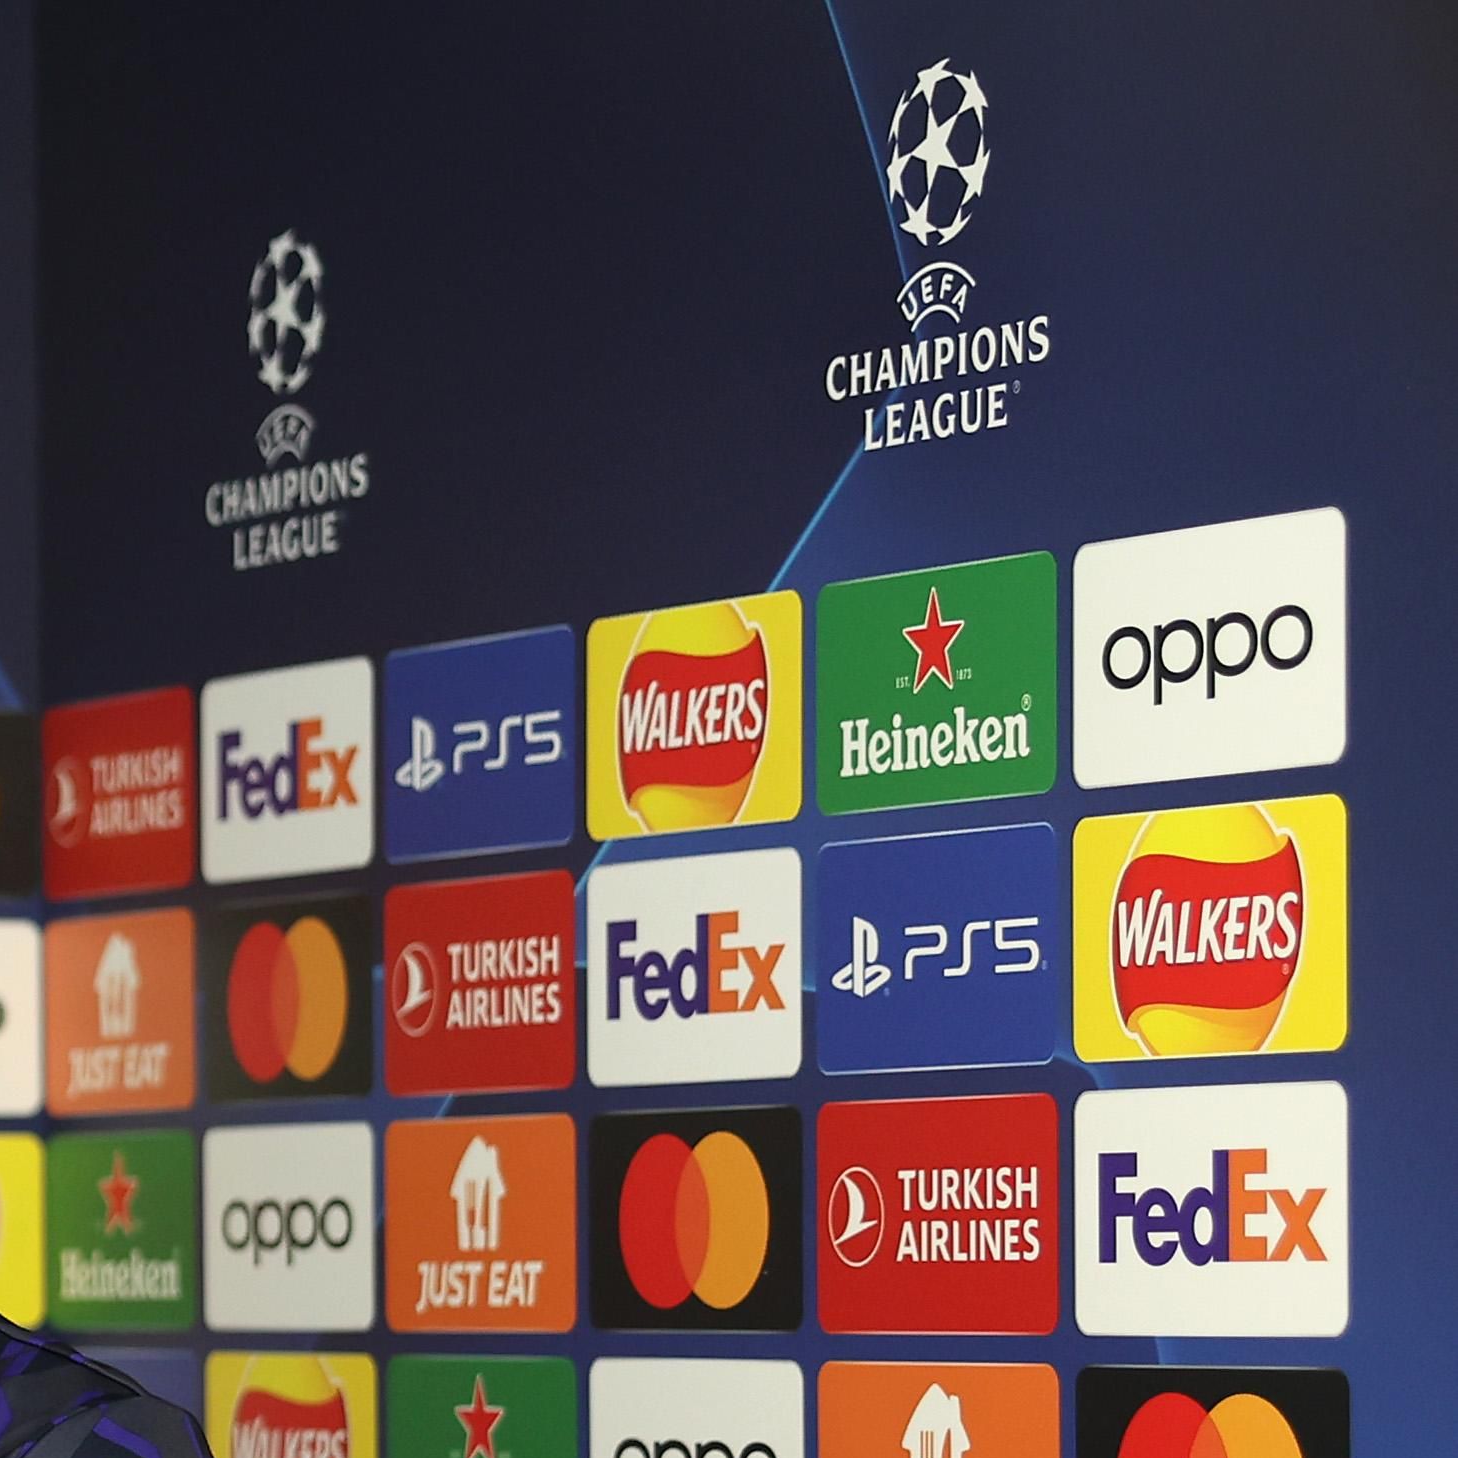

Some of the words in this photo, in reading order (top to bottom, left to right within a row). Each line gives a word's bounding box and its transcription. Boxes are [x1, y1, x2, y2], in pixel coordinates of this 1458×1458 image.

[901, 274, 967, 321] UEFA
[826, 315, 1049, 401] CHAMPIONS
[864, 383, 1008, 451] LEAGUE
[204, 452, 369, 527] CHAMPIONS
[232, 509, 341, 571] LEAGUE
[1102, 603, 1314, 706] oppo
[452, 709, 563, 773] PS5
[619, 677, 765, 753] WALKERS
[840, 706, 1031, 778] Heineken
[90, 747, 183, 789] TURKISH
[217, 717, 359, 821] FedEx
[89, 792, 184, 835] AIRLINES
[904, 916, 1041, 980] PS5
[1115, 888, 1299, 966] WALKERS
[447, 935, 561, 984] TURKISH
[606, 910, 786, 1021] FedEx
[445, 982, 562, 1029] AIRLINES
[67, 1046, 118, 1098] JUST
[121, 1043, 170, 1089] EAT
[897, 1166, 1039, 1212] TURKISH
[1098, 1148, 1327, 1268] FedEx
[221, 1197, 354, 1266] oppo
[896, 1216, 1042, 1263] AIRLINES
[59, 1248, 182, 1300] Heineken
[415, 1261, 485, 1313] JUST
[487, 1258, 546, 1308] EAT
